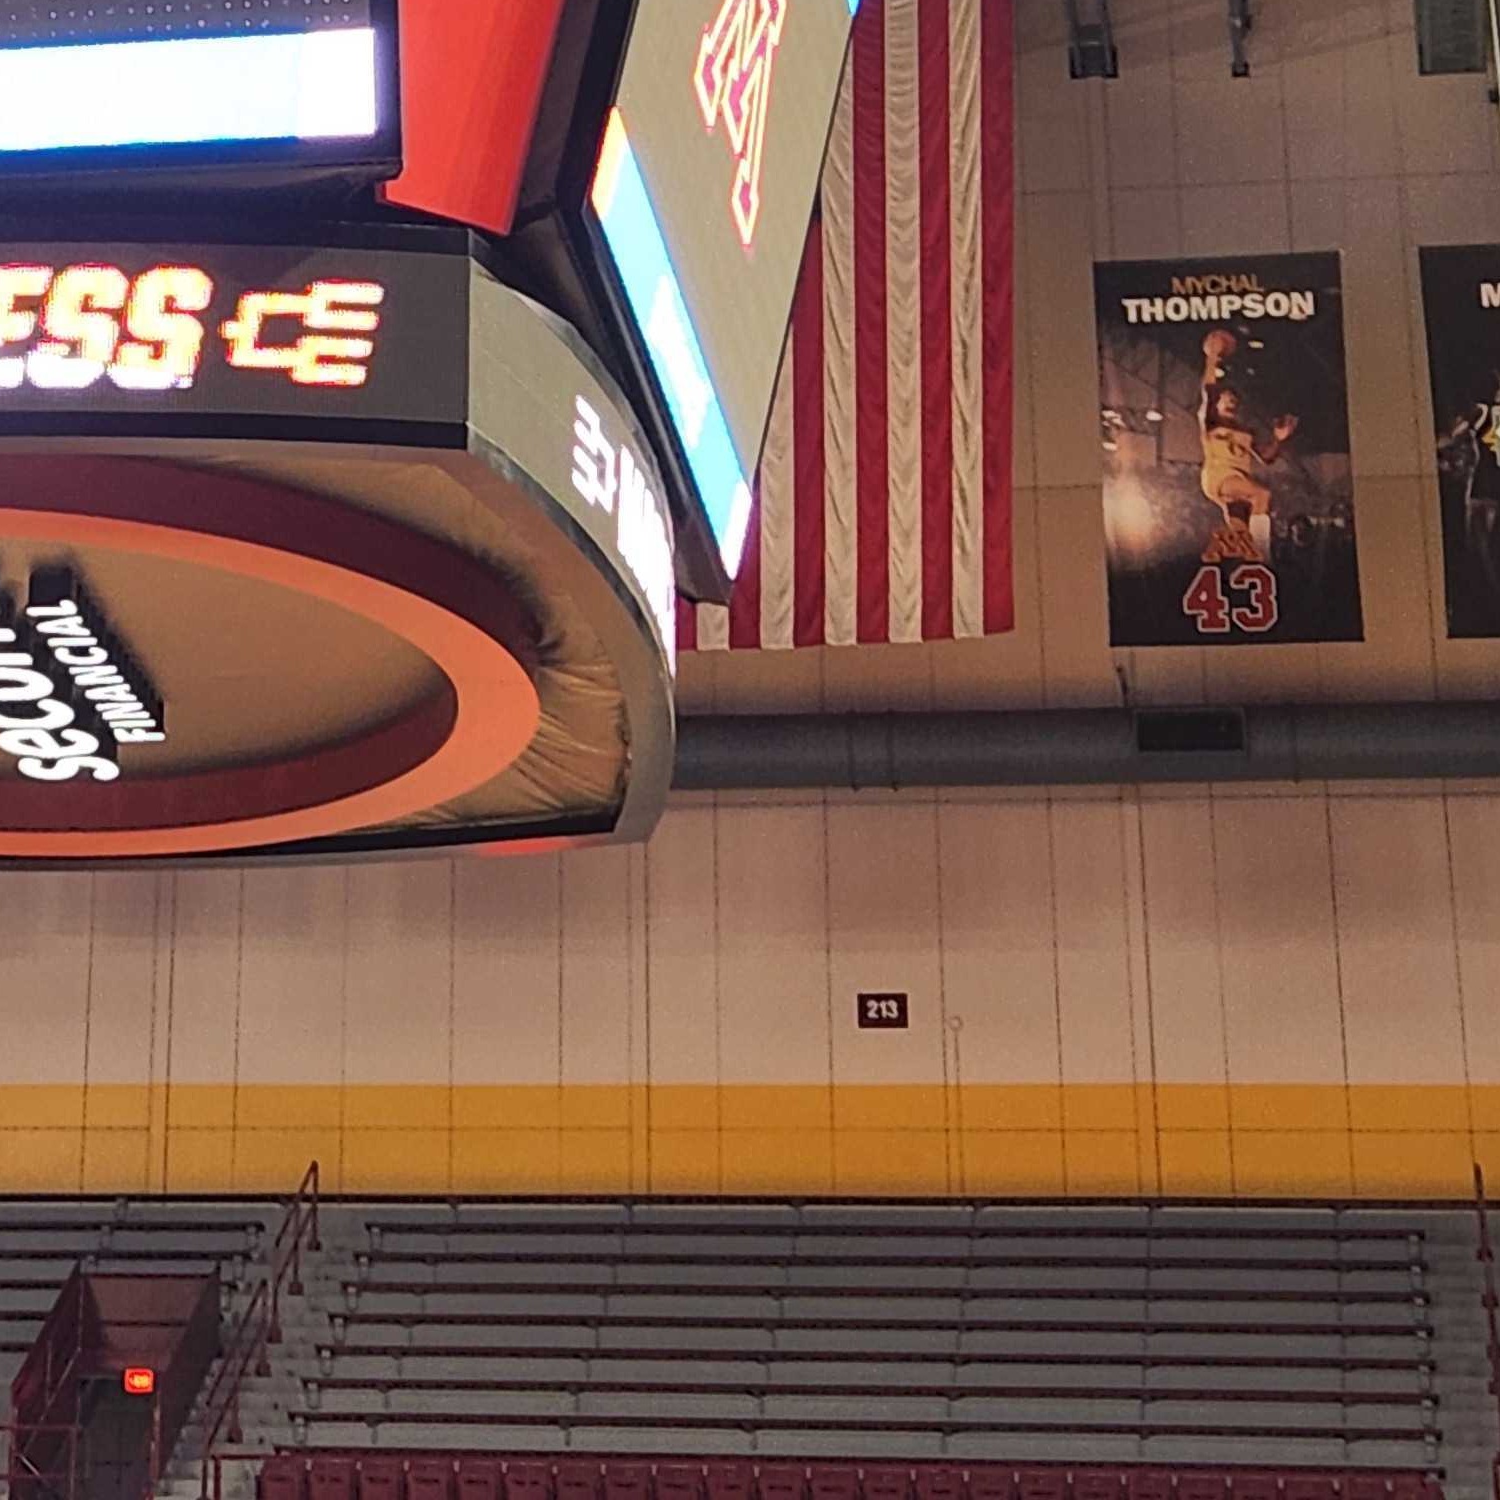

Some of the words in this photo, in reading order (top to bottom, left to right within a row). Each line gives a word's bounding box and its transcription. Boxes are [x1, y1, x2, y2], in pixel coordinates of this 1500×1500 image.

[1171, 273, 1265, 295] MYCHAL
[1121, 290, 1316, 324] THOMPSON
[1183, 564, 1279, 633] 43
[25, 599, 166, 743] FINANCIAL
[866, 999, 899, 1019] 213
